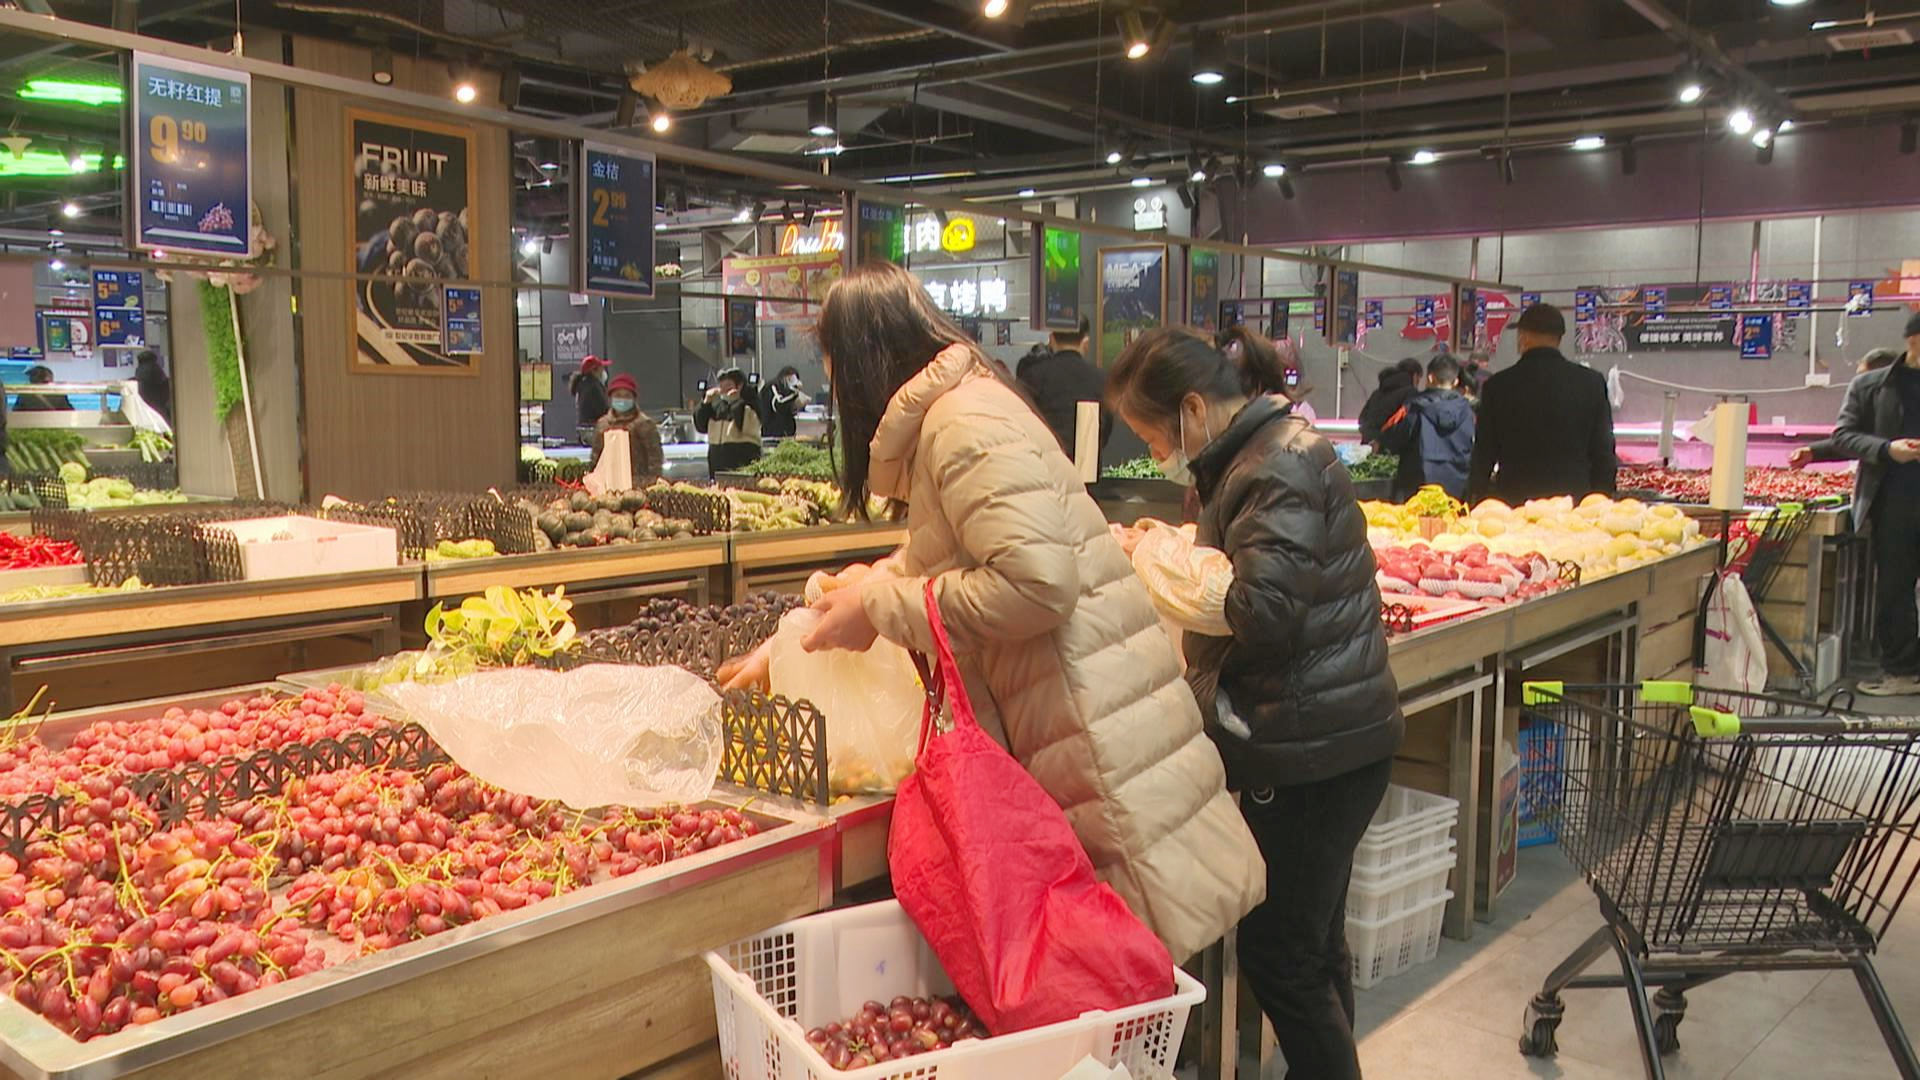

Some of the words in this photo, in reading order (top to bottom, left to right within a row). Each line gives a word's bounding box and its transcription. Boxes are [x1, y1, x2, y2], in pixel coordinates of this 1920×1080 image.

[148, 76, 223, 108] 无籽红提
[361, 141, 449, 181] FRUIT
[363, 173, 428, 198] 新鲜美味
